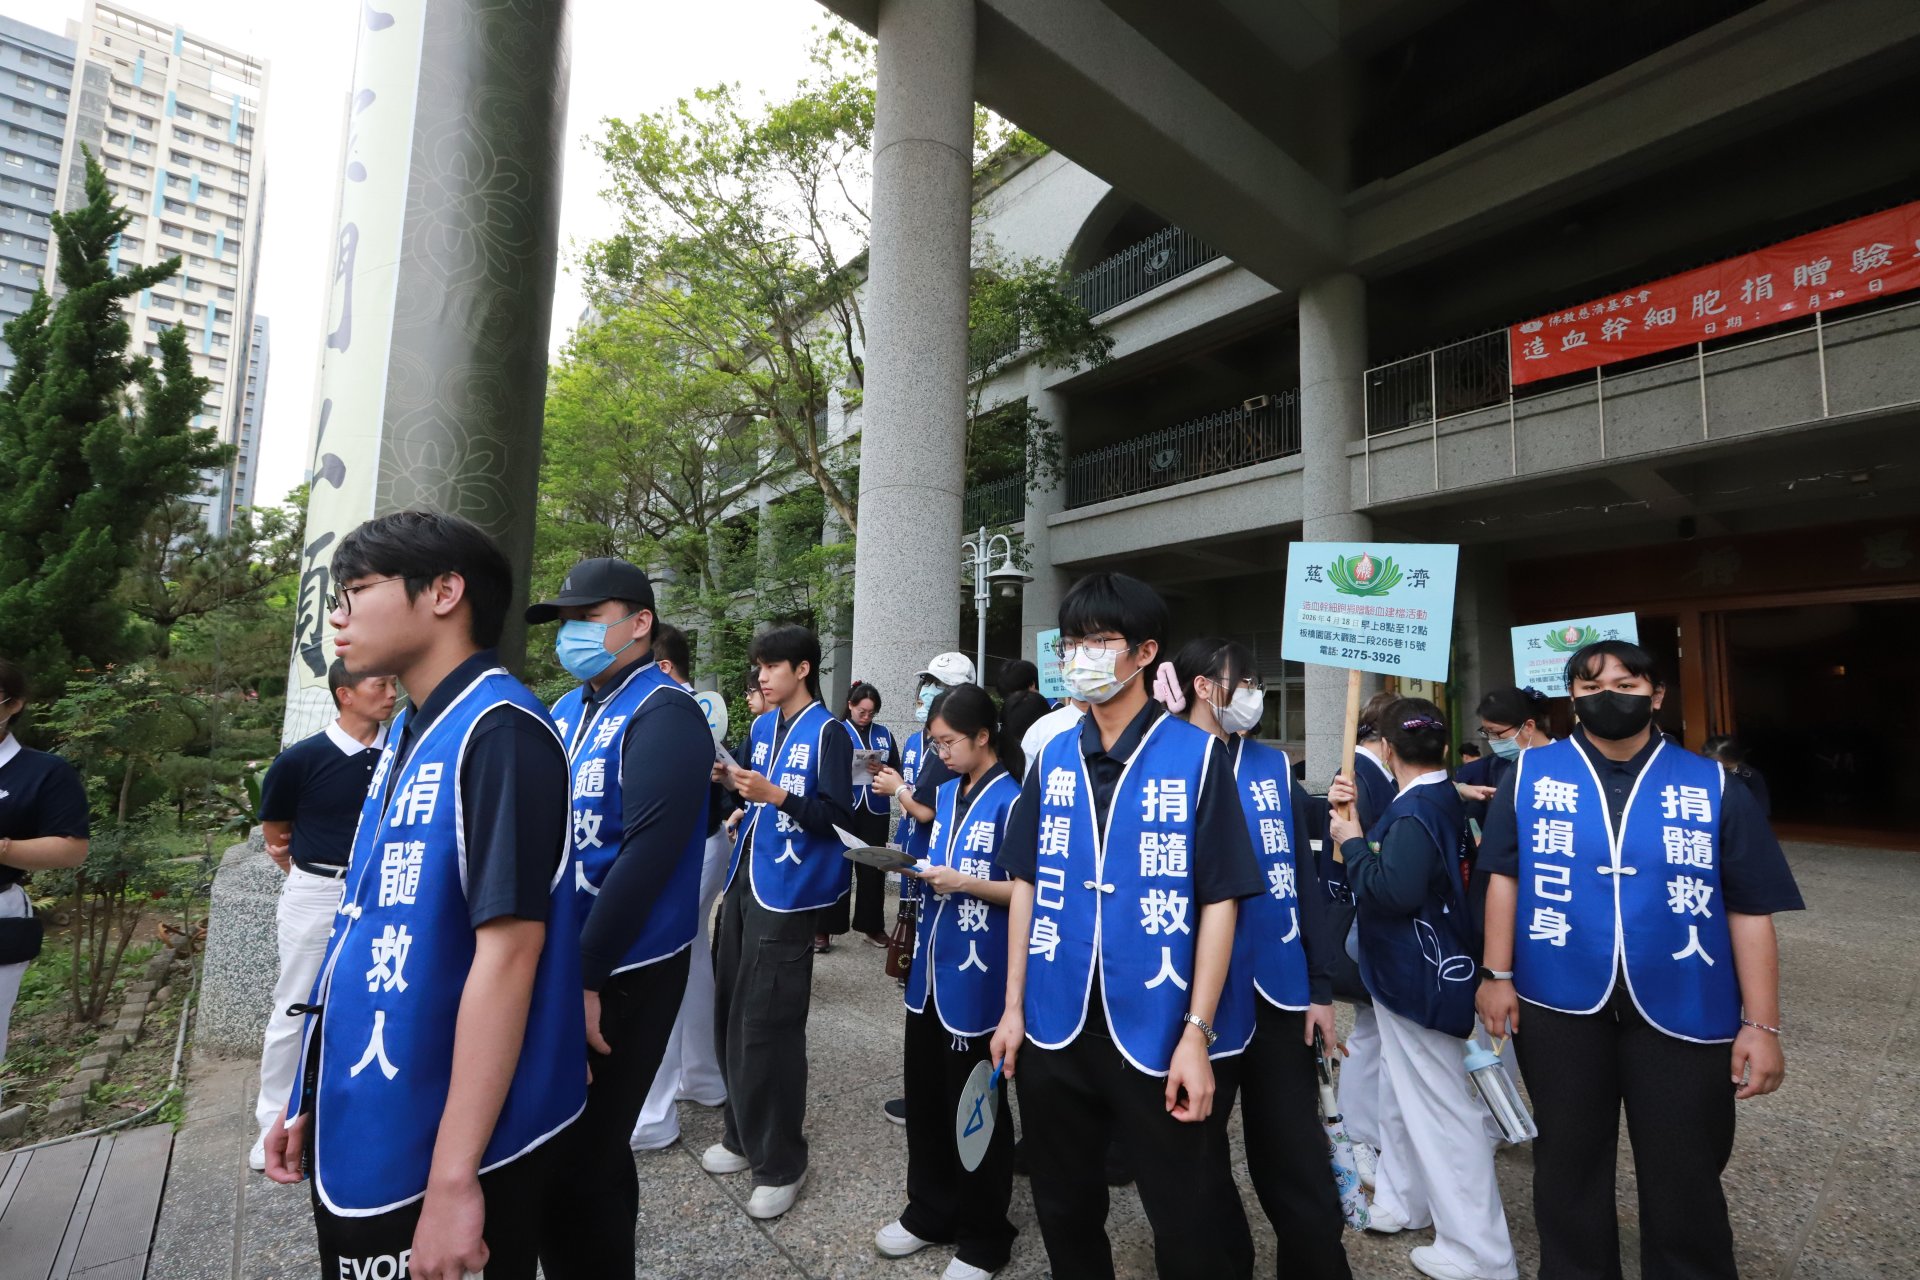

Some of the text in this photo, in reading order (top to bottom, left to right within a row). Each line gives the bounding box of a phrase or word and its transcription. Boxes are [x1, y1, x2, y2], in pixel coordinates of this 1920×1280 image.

[1523, 239, 1920, 360] 造血幹細胞捐贈驗
[1304, 564, 1430, 589] 慈 濟
[1341, 648, 1401, 664] 2275-3926
[350, 762, 444, 1080] 捐髓救人
[1028, 766, 1077, 962] 無損己身
[1139, 779, 1190, 991] 捐髓救人
[1529, 776, 1579, 947] 無損己身
[1660, 784, 1715, 967] 捐髓救人
